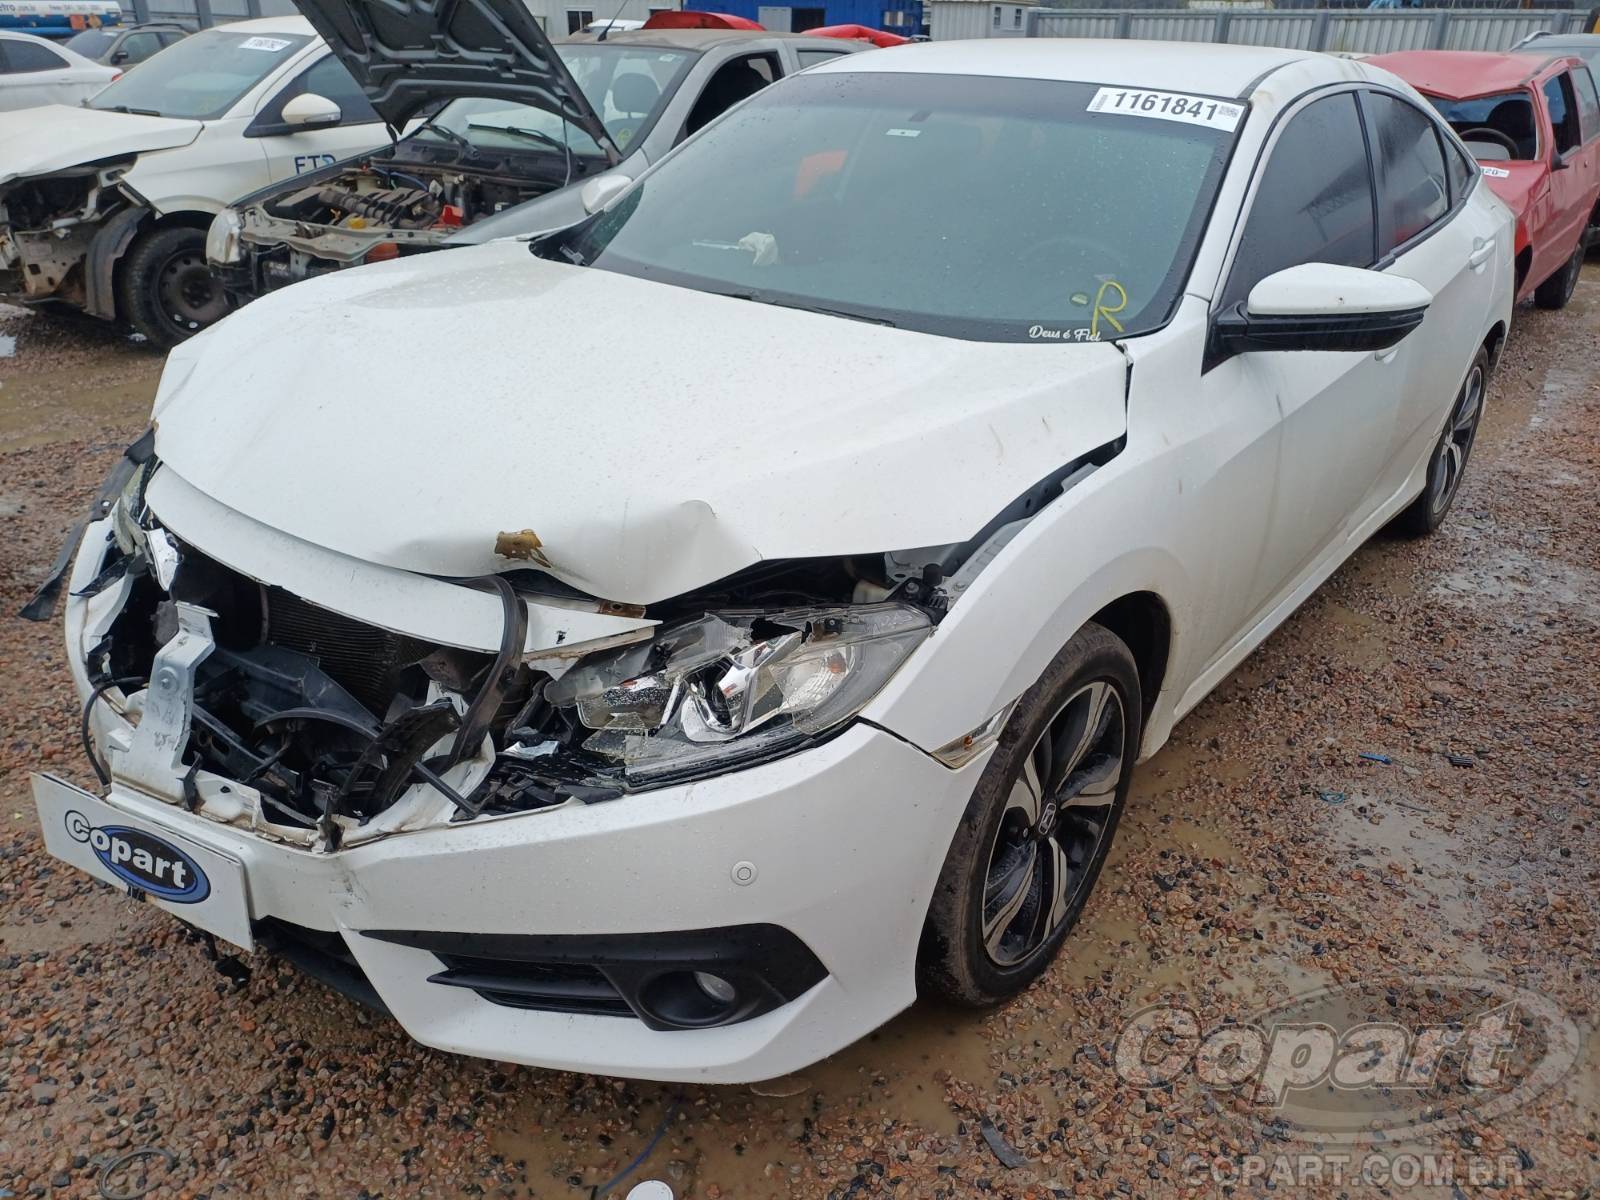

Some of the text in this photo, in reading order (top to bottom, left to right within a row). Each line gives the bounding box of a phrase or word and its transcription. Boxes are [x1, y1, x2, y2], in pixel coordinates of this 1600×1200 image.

[1114, 91, 1218, 121] 1161841
[1091, 280, 1127, 336] R
[1029, 325, 1061, 338] Deus
[1063, 329, 1071, 339] é
[64, 810, 187, 889] Copart
